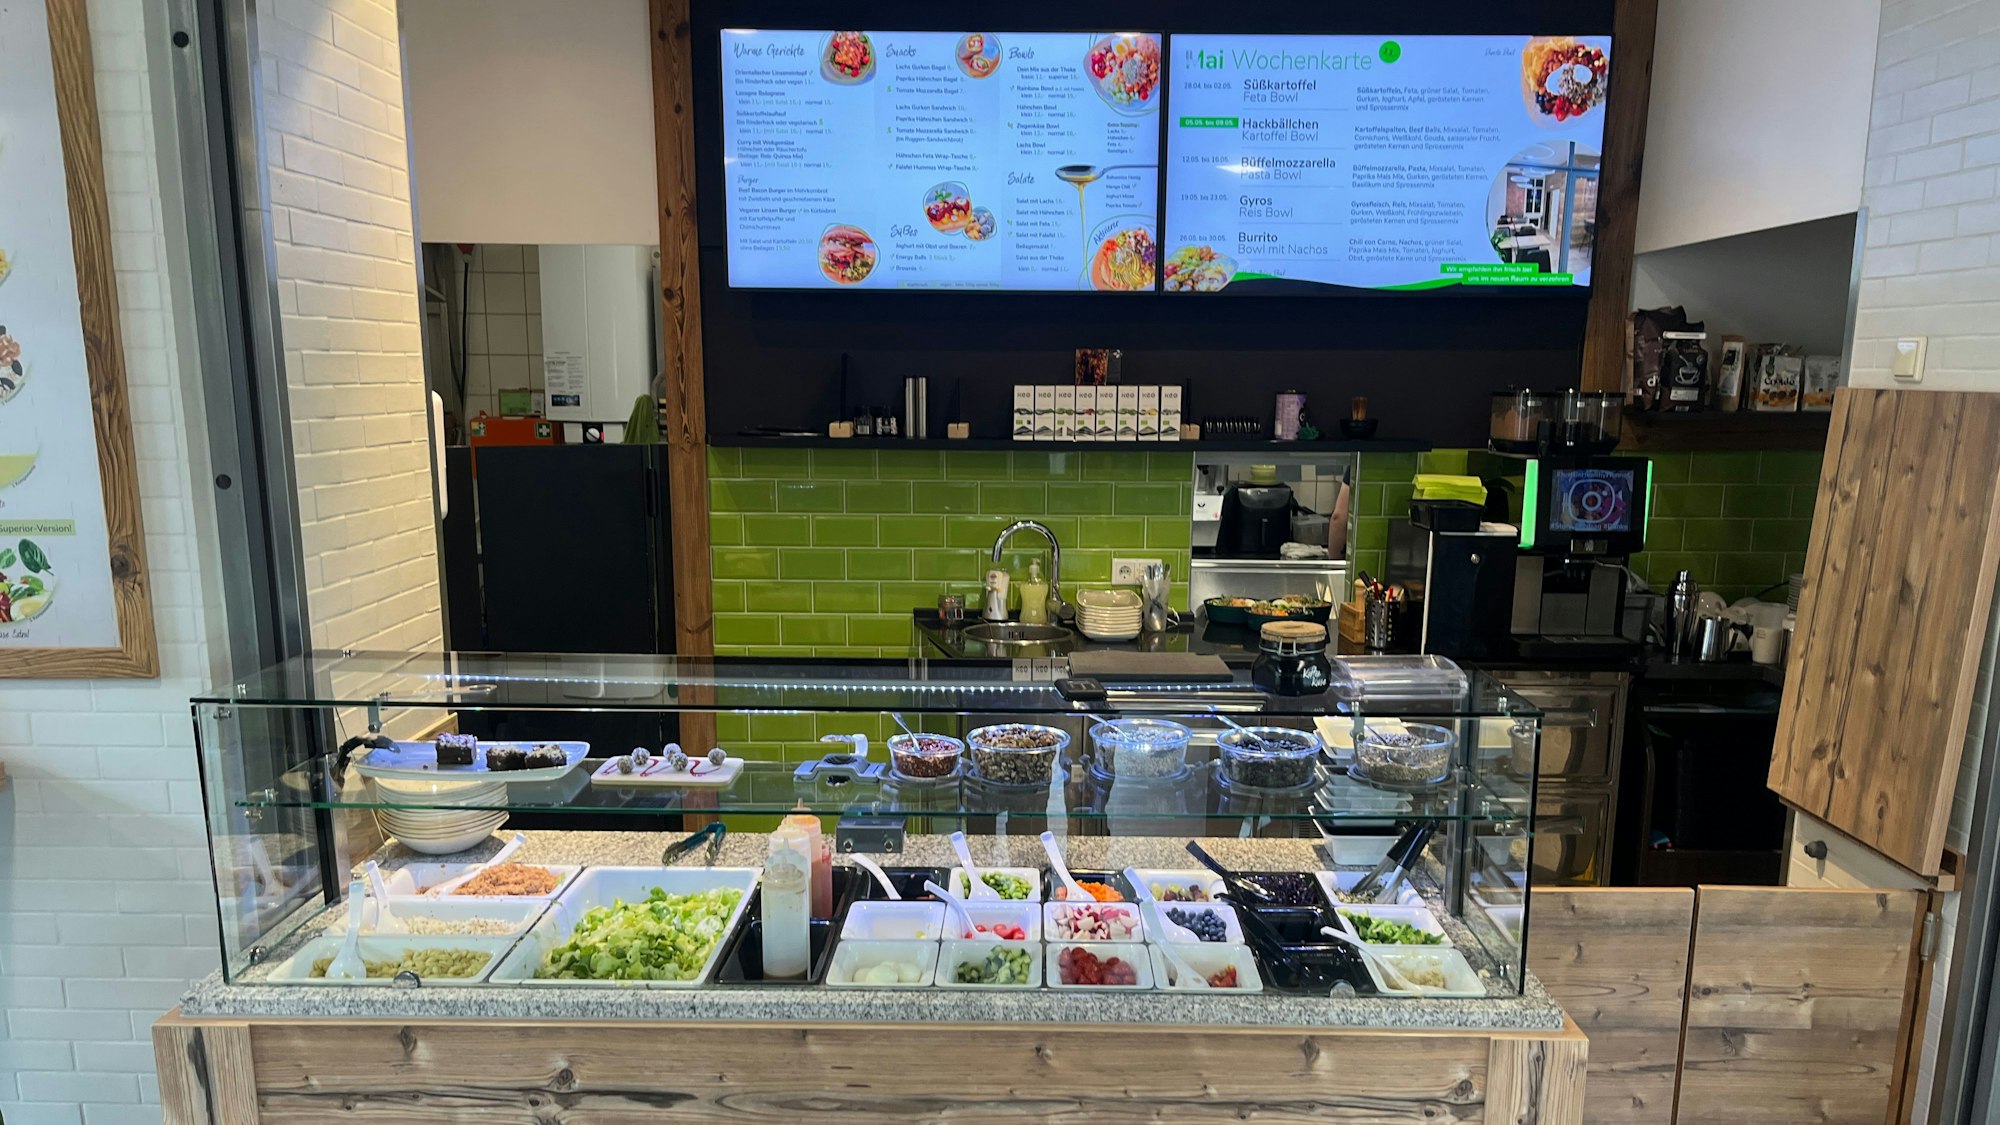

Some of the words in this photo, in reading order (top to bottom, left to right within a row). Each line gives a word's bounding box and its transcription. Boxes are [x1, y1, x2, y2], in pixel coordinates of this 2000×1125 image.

[885, 43, 917, 58] Snacks
[1008, 46, 1035, 60] Bowls
[1231, 47, 1372, 71] Wochenkarte
[1243, 79, 1317, 91] Süßkartoffel
[1404, 87, 1420, 95] Feta,
[1461, 87, 1490, 95] Tomaten,
[1243, 91, 1267, 103] Feta
[1270, 91, 1298, 103] Bowl
[1242, 118, 1319, 130] Hackbällchen
[1472, 126, 1500, 134] Tomaten,
[1241, 130, 1288, 142] Kartoffel
[1290, 131, 1319, 142] Bowl
[1241, 157, 1336, 169] Büffelmozzarella
[1408, 164, 1428, 172] Pasta,
[1240, 169, 1271, 180] Pasta
[1273, 169, 1302, 180] Bowl
[1239, 195, 1273, 208] Gyros
[1239, 206, 1263, 218] Reis
[1265, 207, 1293, 218] Bowl
[1238, 232, 1278, 243] Burrito
[1237, 244, 1267, 255] Bowl
[1268, 244, 1285, 254] mit
[1288, 244, 1328, 255] Nachos
[0, 524, 72, 534] Superior-Version!
